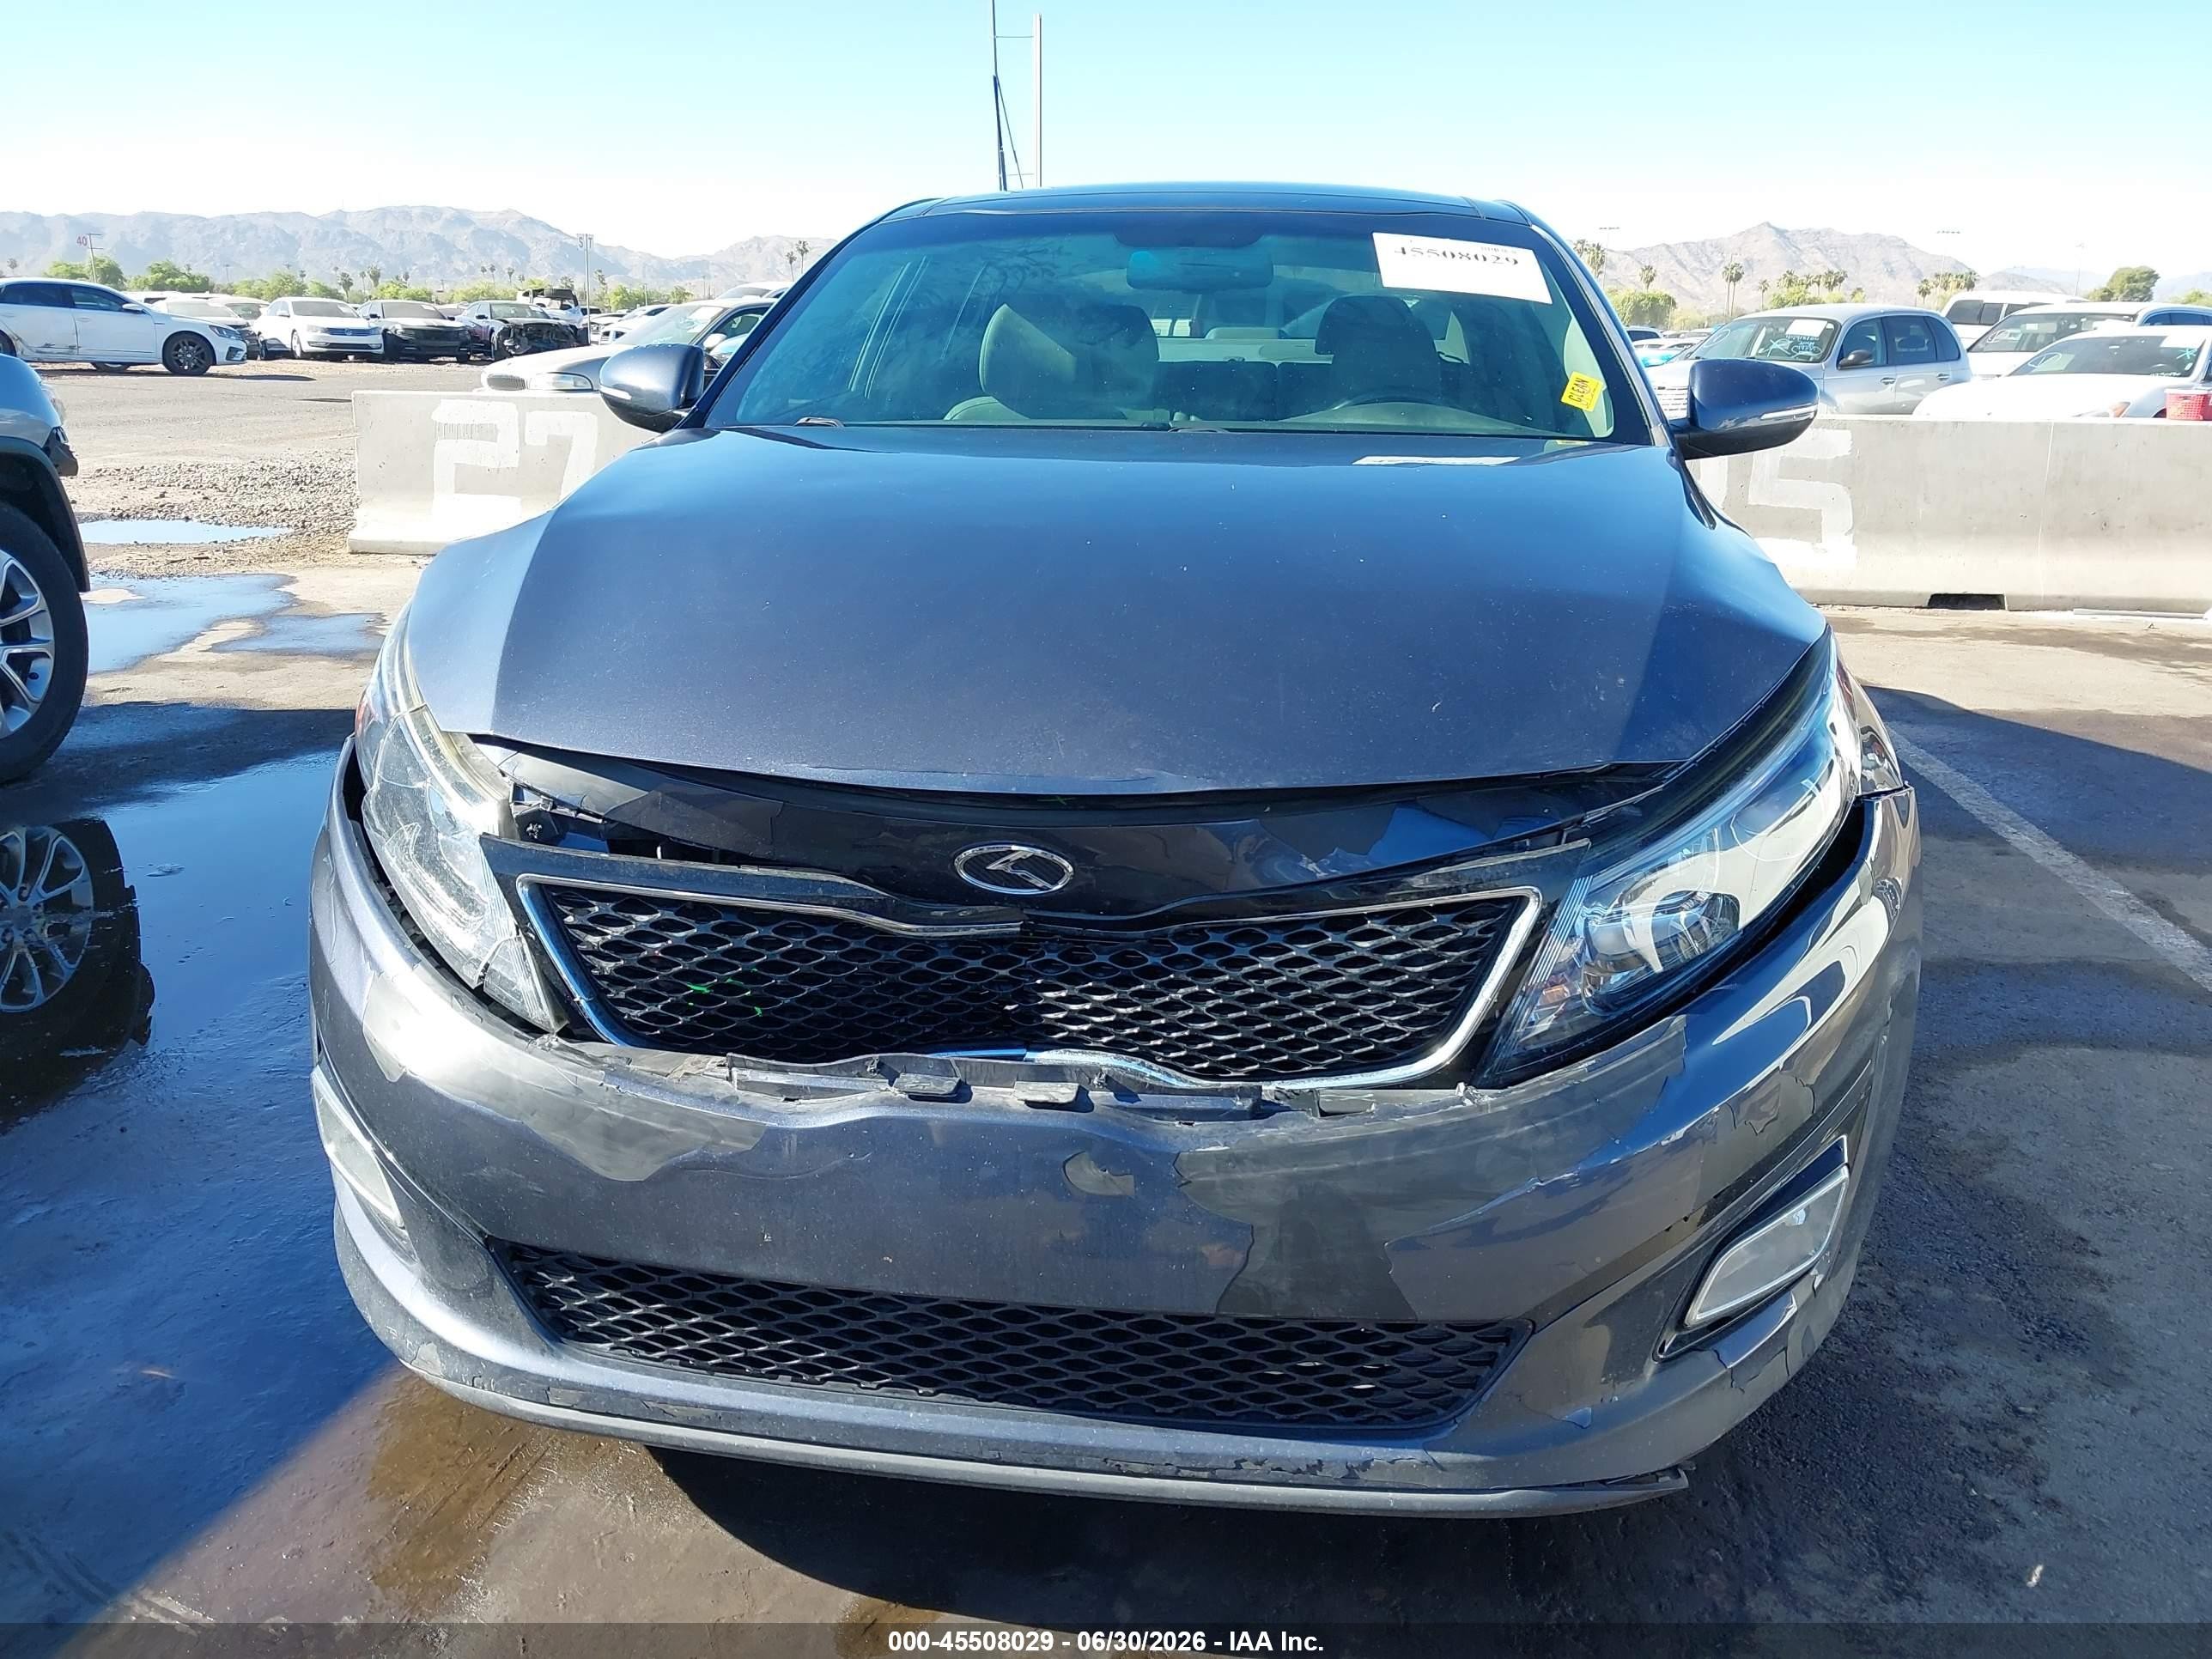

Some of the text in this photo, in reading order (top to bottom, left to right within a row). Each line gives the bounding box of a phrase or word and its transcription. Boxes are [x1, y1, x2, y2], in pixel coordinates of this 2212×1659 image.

[76, 235, 88, 246] 40
[1568, 377, 1589, 403] CLEAN
[431, 398, 599, 526] 27
